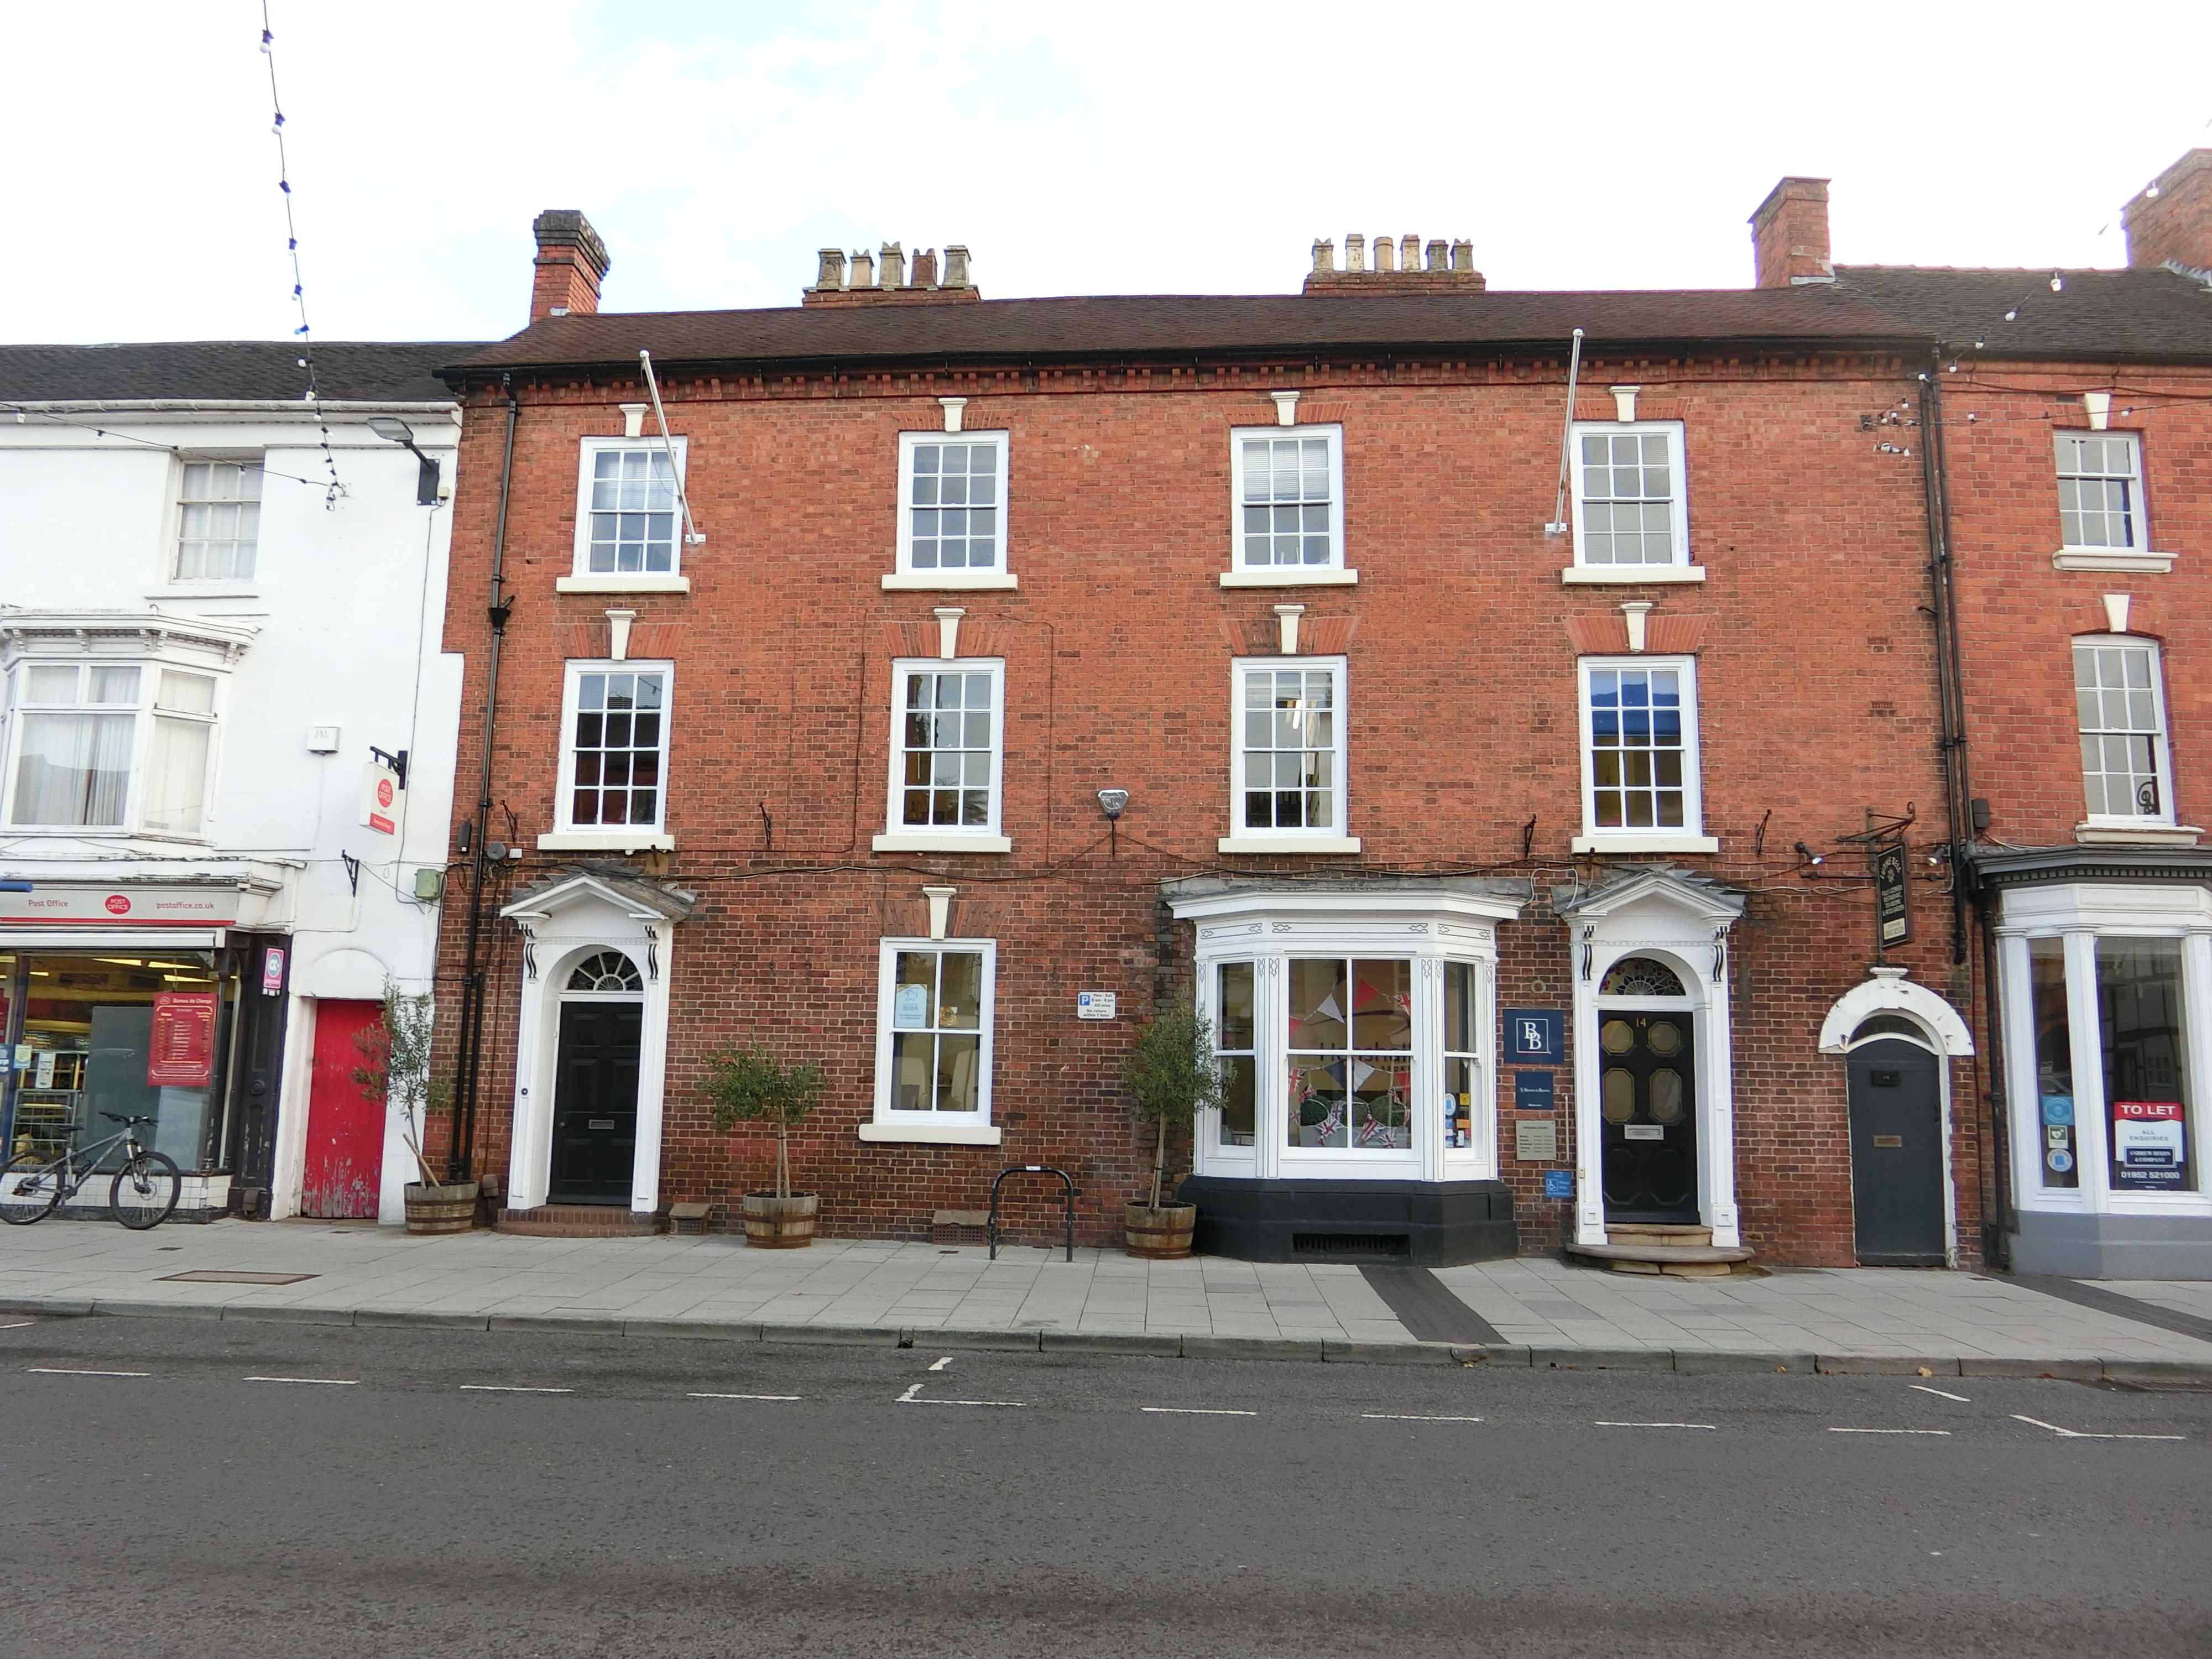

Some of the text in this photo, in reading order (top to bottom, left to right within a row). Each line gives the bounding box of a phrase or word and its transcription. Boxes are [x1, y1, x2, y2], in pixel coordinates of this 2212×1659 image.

[156, 901, 213, 910] postoffice.co.uk
[1082, 996, 1089, 1005] P
[2120, 1105, 2176, 1115] TO LET
